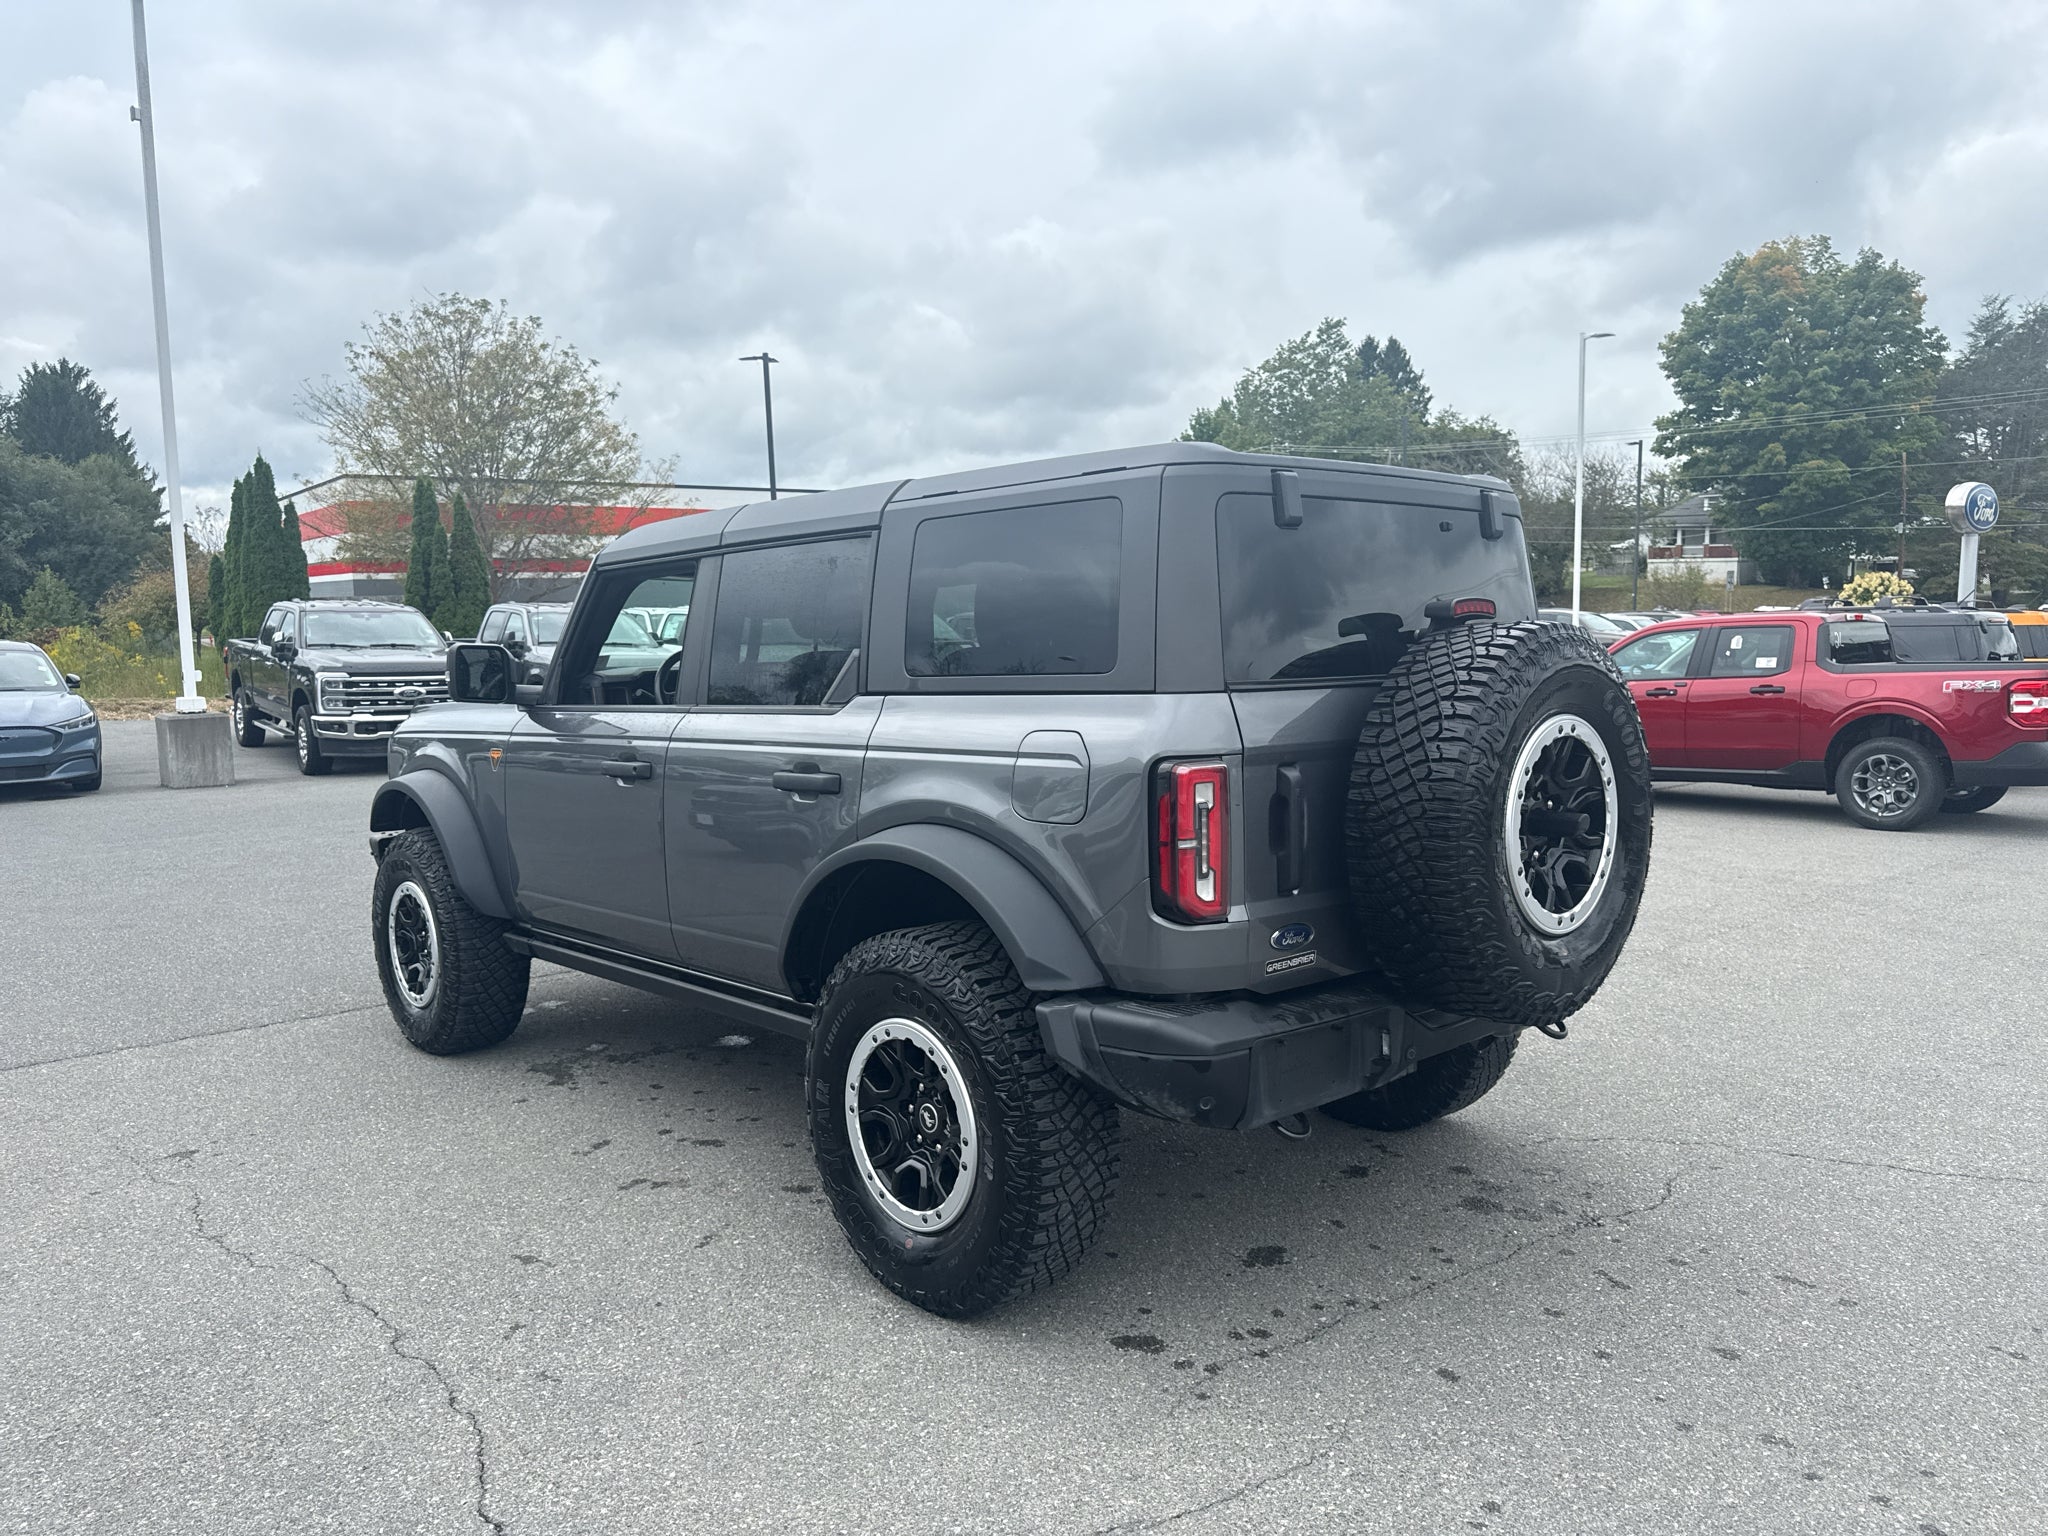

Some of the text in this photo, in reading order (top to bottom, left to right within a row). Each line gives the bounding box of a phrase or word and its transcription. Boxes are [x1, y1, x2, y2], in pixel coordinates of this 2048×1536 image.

[1974, 494, 1995, 521] Ford
[1942, 680, 2002, 693] FX4
[1282, 931, 1305, 945] Ford
[1266, 953, 1315, 972] GREENBRIER
